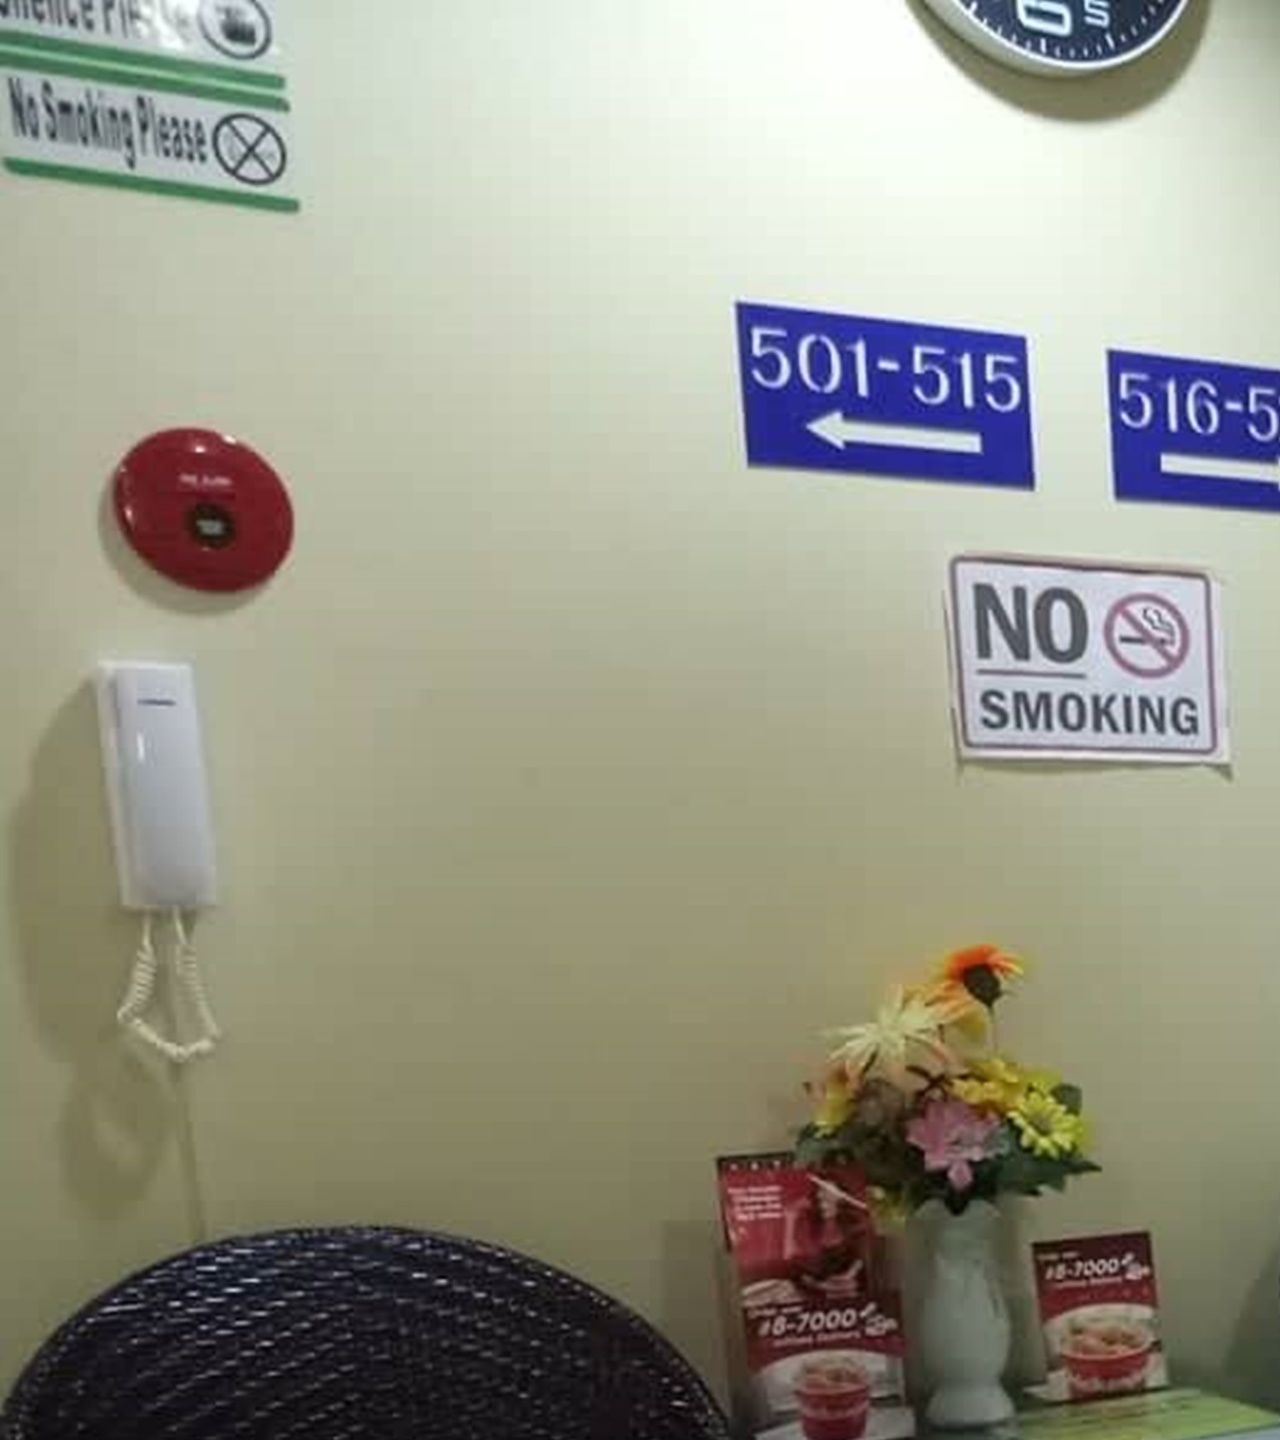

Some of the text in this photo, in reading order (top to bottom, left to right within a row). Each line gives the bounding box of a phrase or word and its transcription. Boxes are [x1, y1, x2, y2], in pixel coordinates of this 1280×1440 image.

[8, 77, 207, 170] No Smoking Please
[749, 326, 1021, 413] 501-515
[972, 582, 1089, 664] NO
[980, 689, 1200, 737] SMOKING
